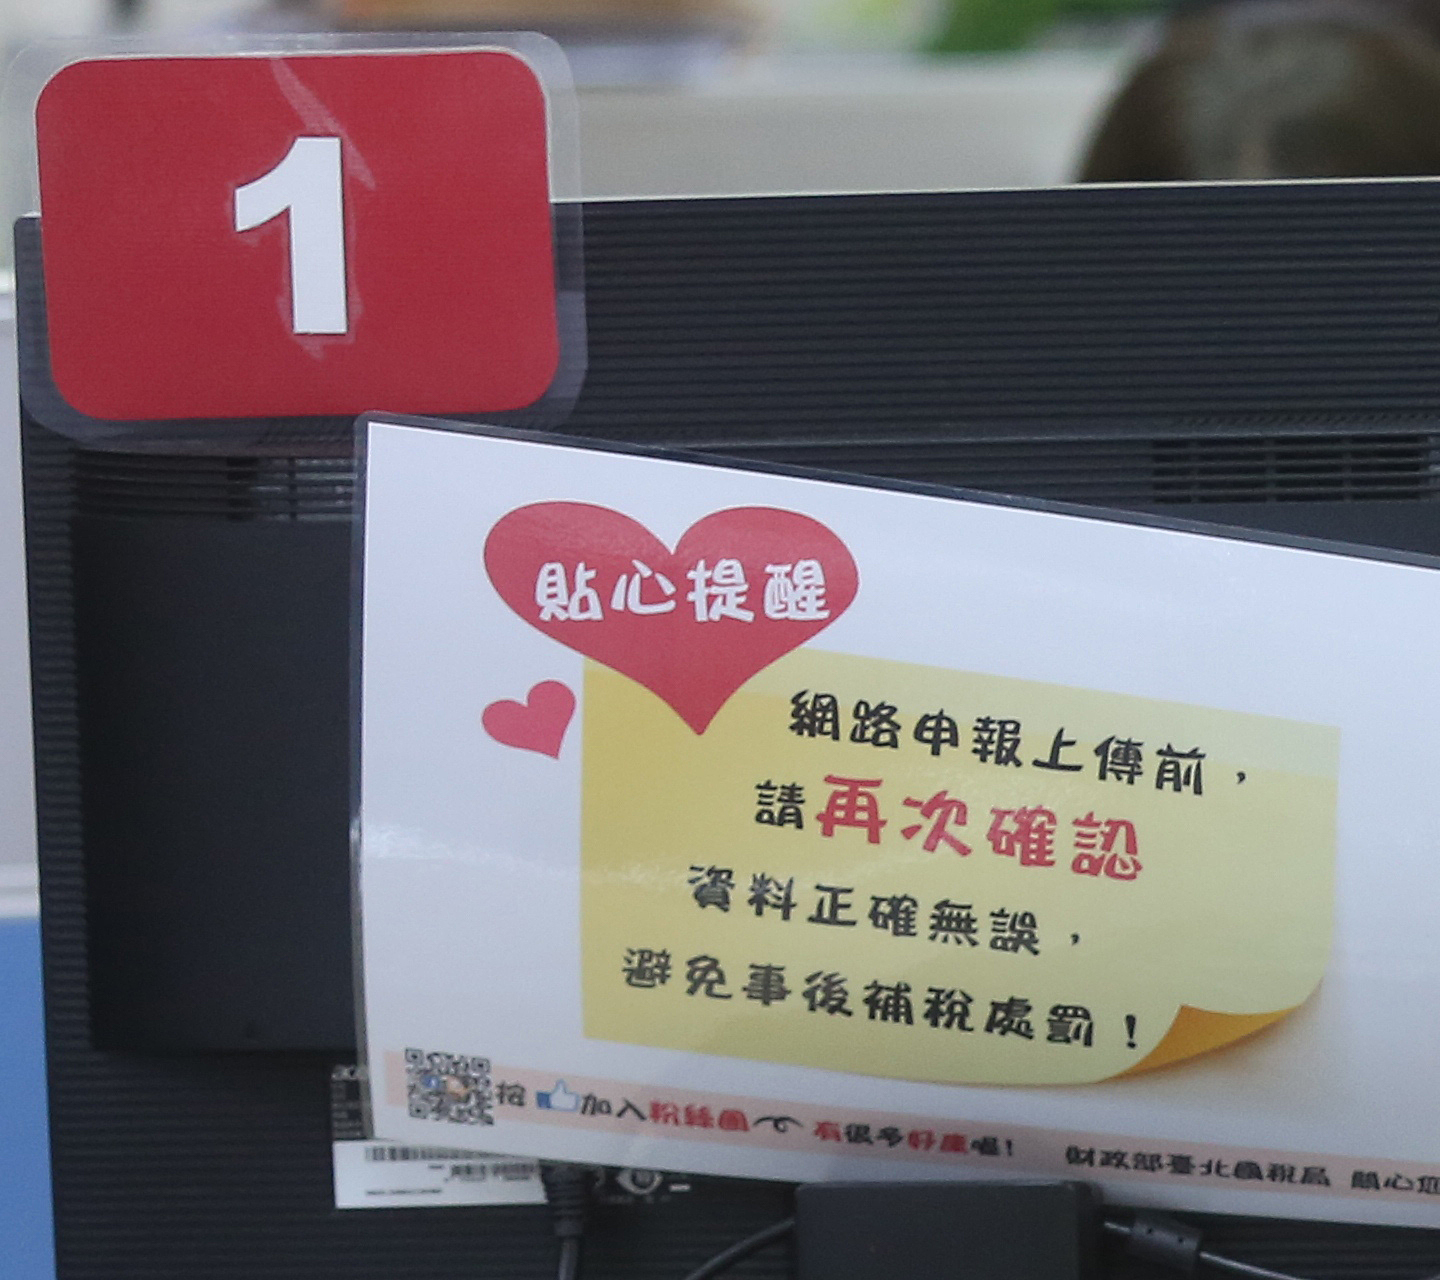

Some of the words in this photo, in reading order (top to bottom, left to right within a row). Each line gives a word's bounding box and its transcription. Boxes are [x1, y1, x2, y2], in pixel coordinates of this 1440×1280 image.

[234, 136, 349, 336] 1
[533, 557, 831, 623] 貼心提醒
[754, 775, 1143, 882] 請再次確認
